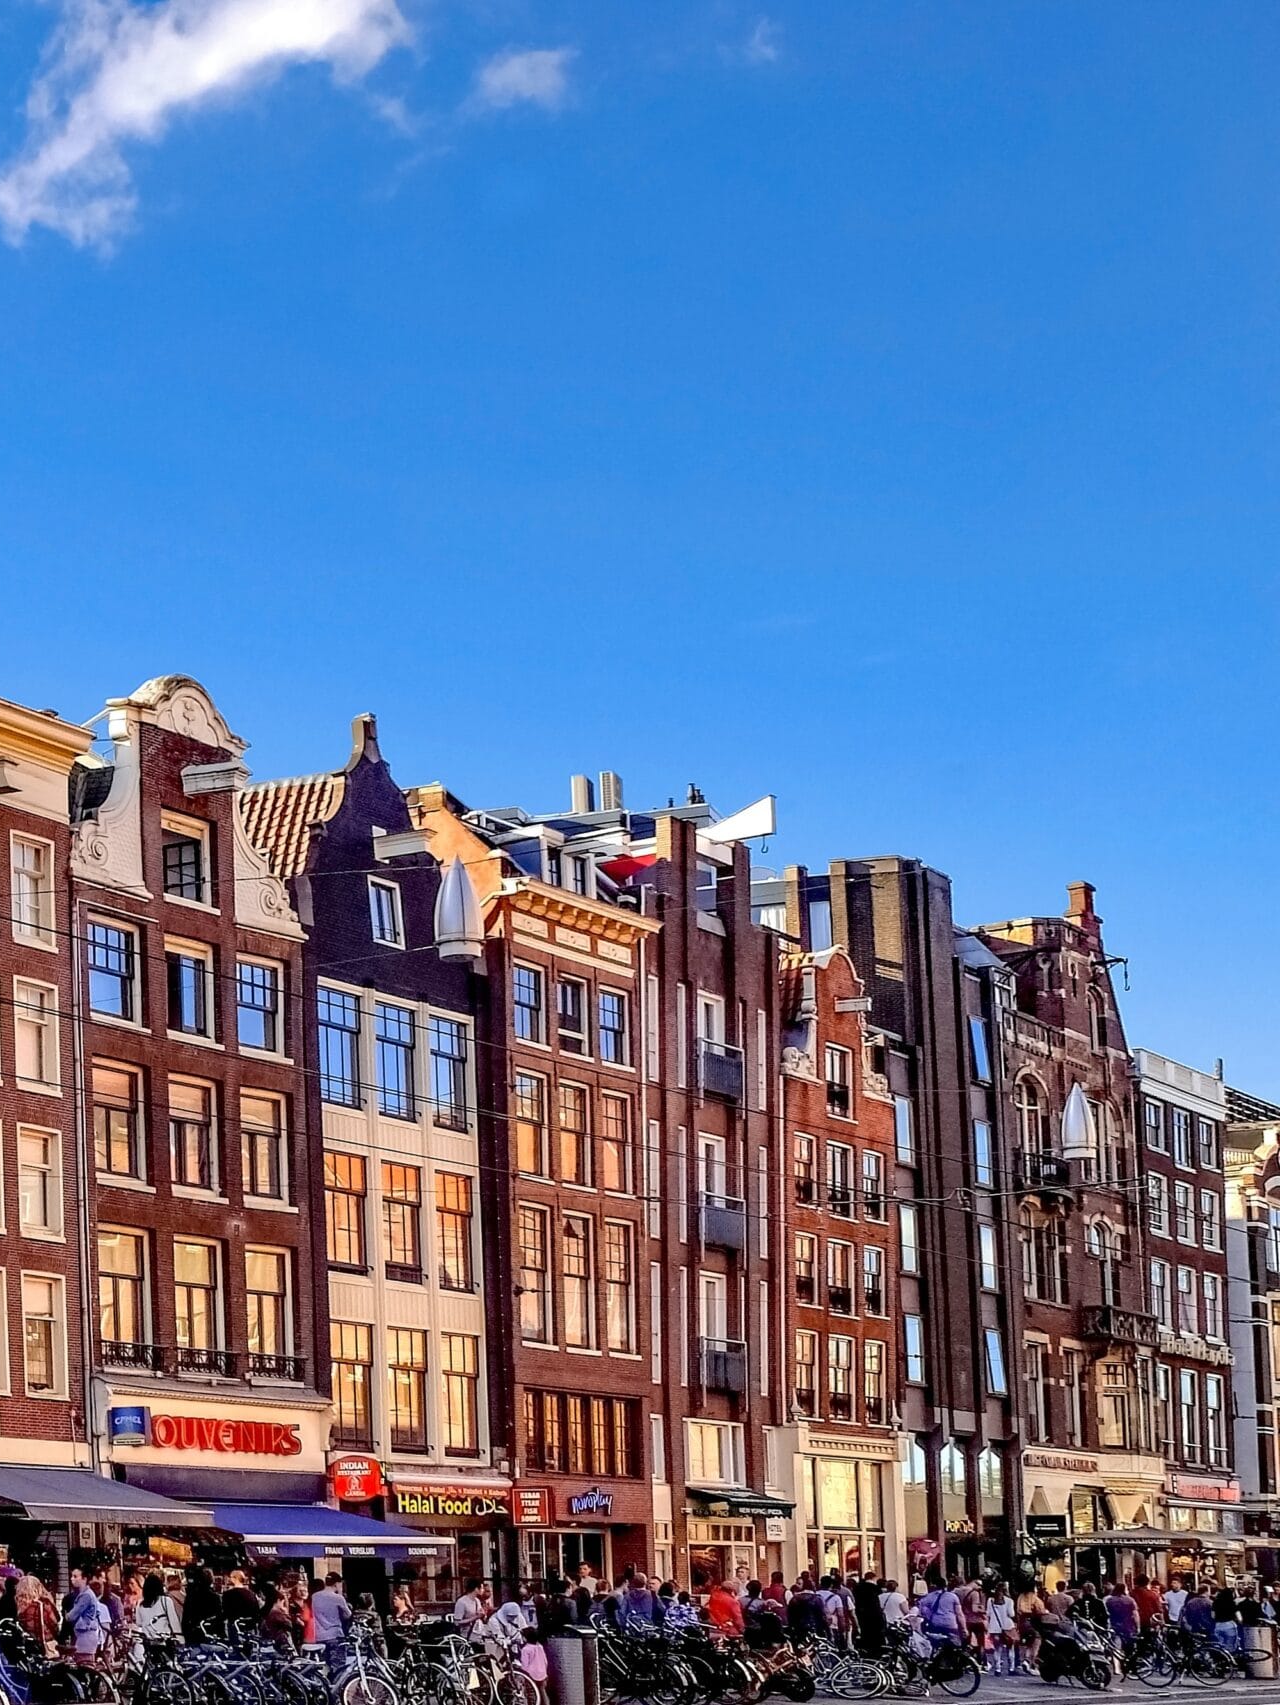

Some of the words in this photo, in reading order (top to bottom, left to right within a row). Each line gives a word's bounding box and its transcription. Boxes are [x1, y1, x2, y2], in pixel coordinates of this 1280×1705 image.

[153, 1415, 302, 1455] OUVENIRS
[339, 1461, 369, 1470] INDIAN
[397, 1494, 435, 1513] Halal
[438, 1496, 472, 1515] Food
[475, 1498, 509, 1516] حلال
[256, 1546, 278, 1555] TABAK
[325, 1546, 345, 1555] FRANS
[408, 1547, 438, 1556] SOUVENIRS
